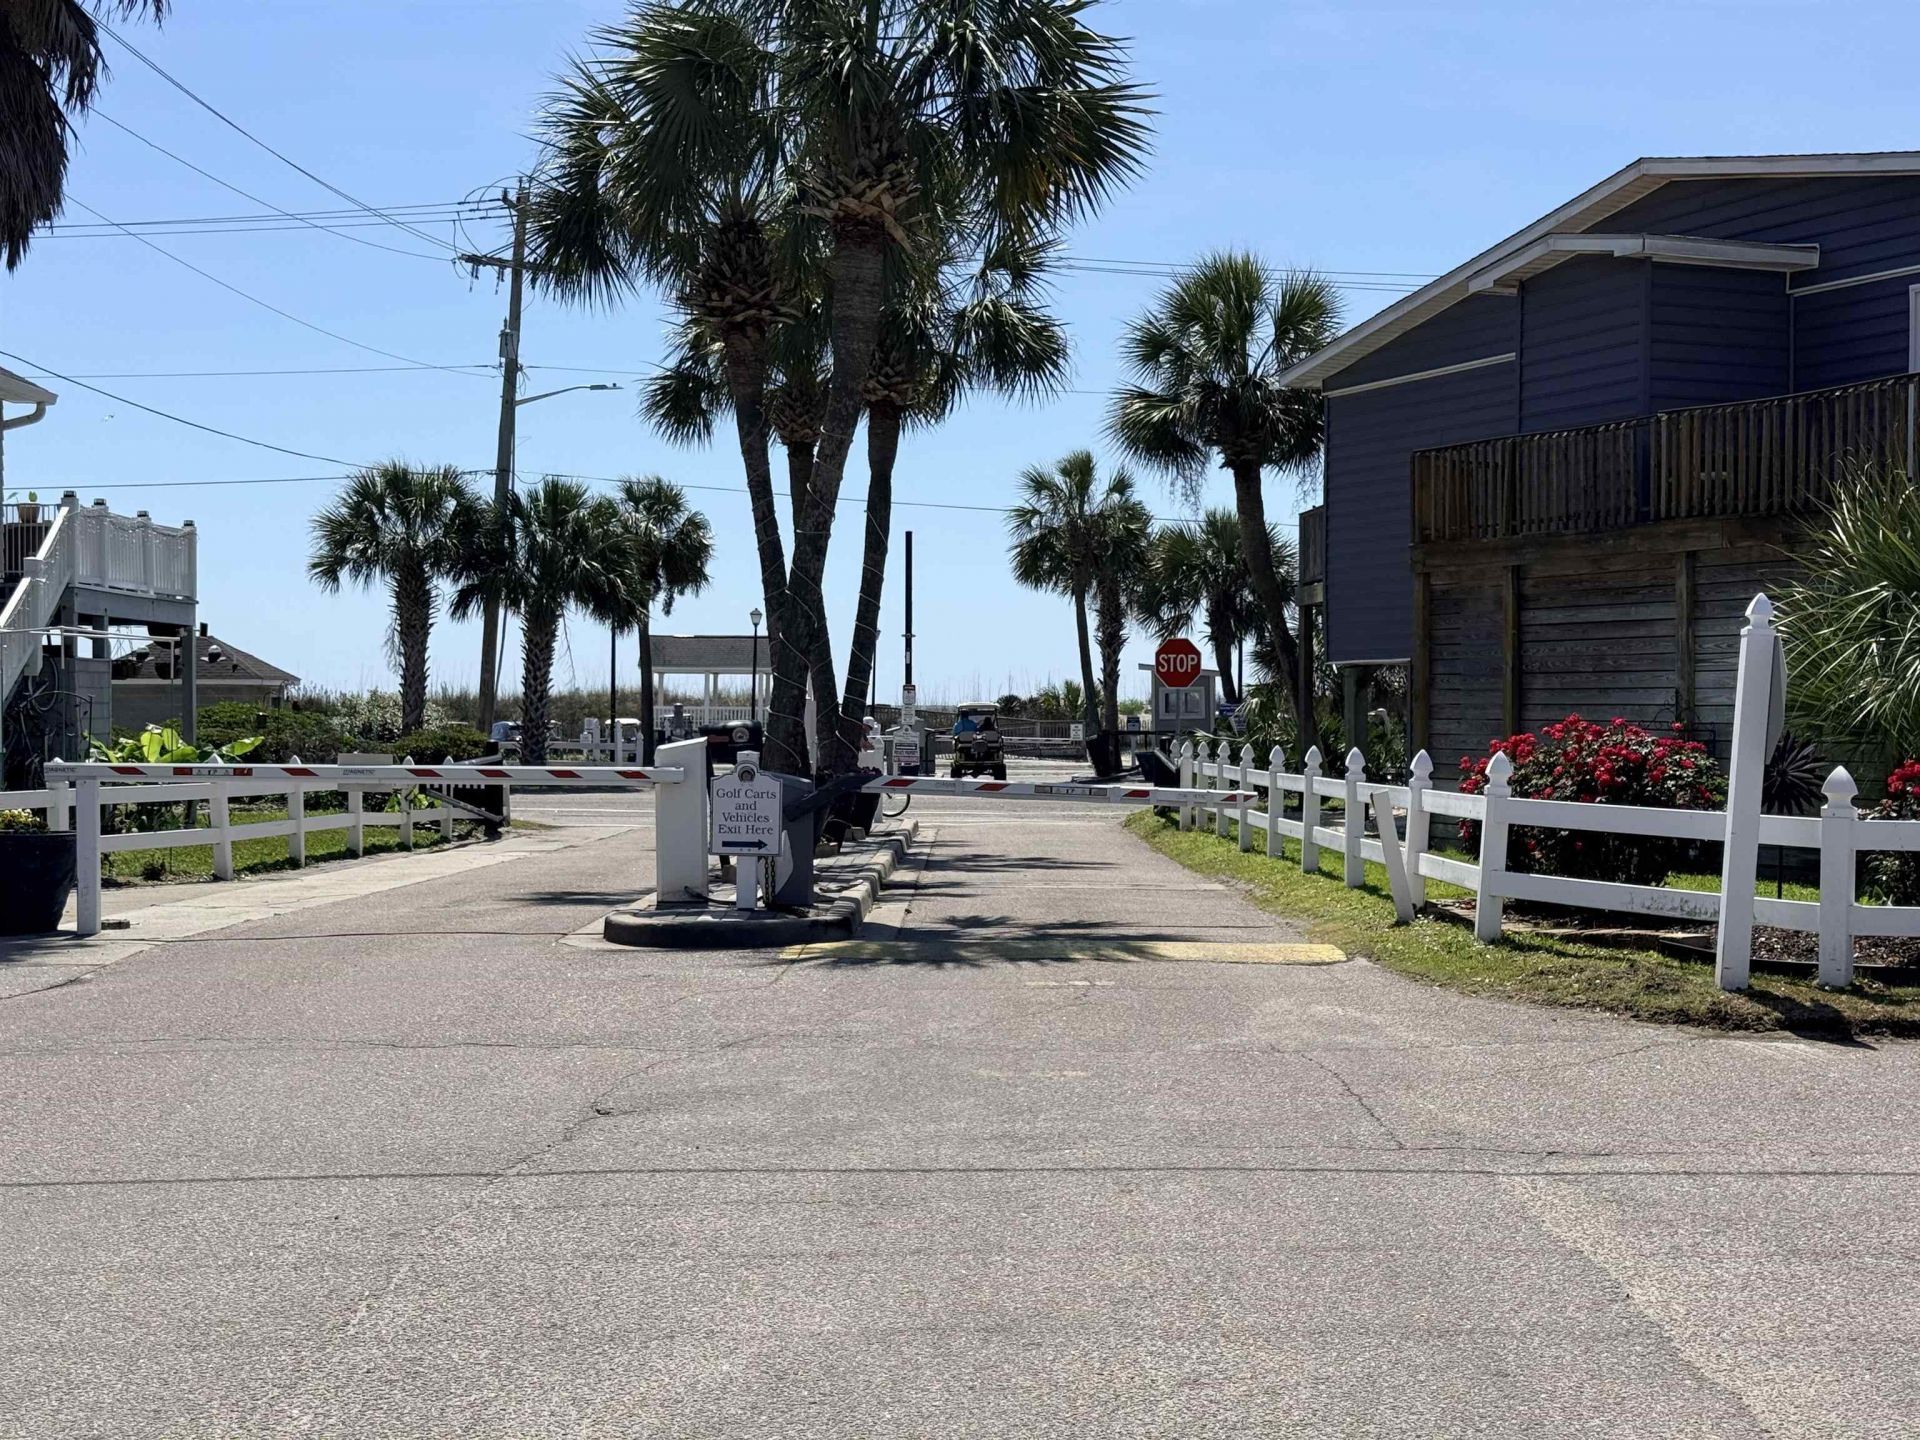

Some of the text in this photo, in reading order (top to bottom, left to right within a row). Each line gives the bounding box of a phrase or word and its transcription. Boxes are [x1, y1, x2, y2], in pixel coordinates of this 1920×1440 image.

[1158, 653, 1198, 673] STOP
[716, 788, 776, 799] Golf Carts
[734, 800, 757, 811] and
[722, 812, 770, 823] Vehicles
[718, 824, 774, 835] Exit Here
